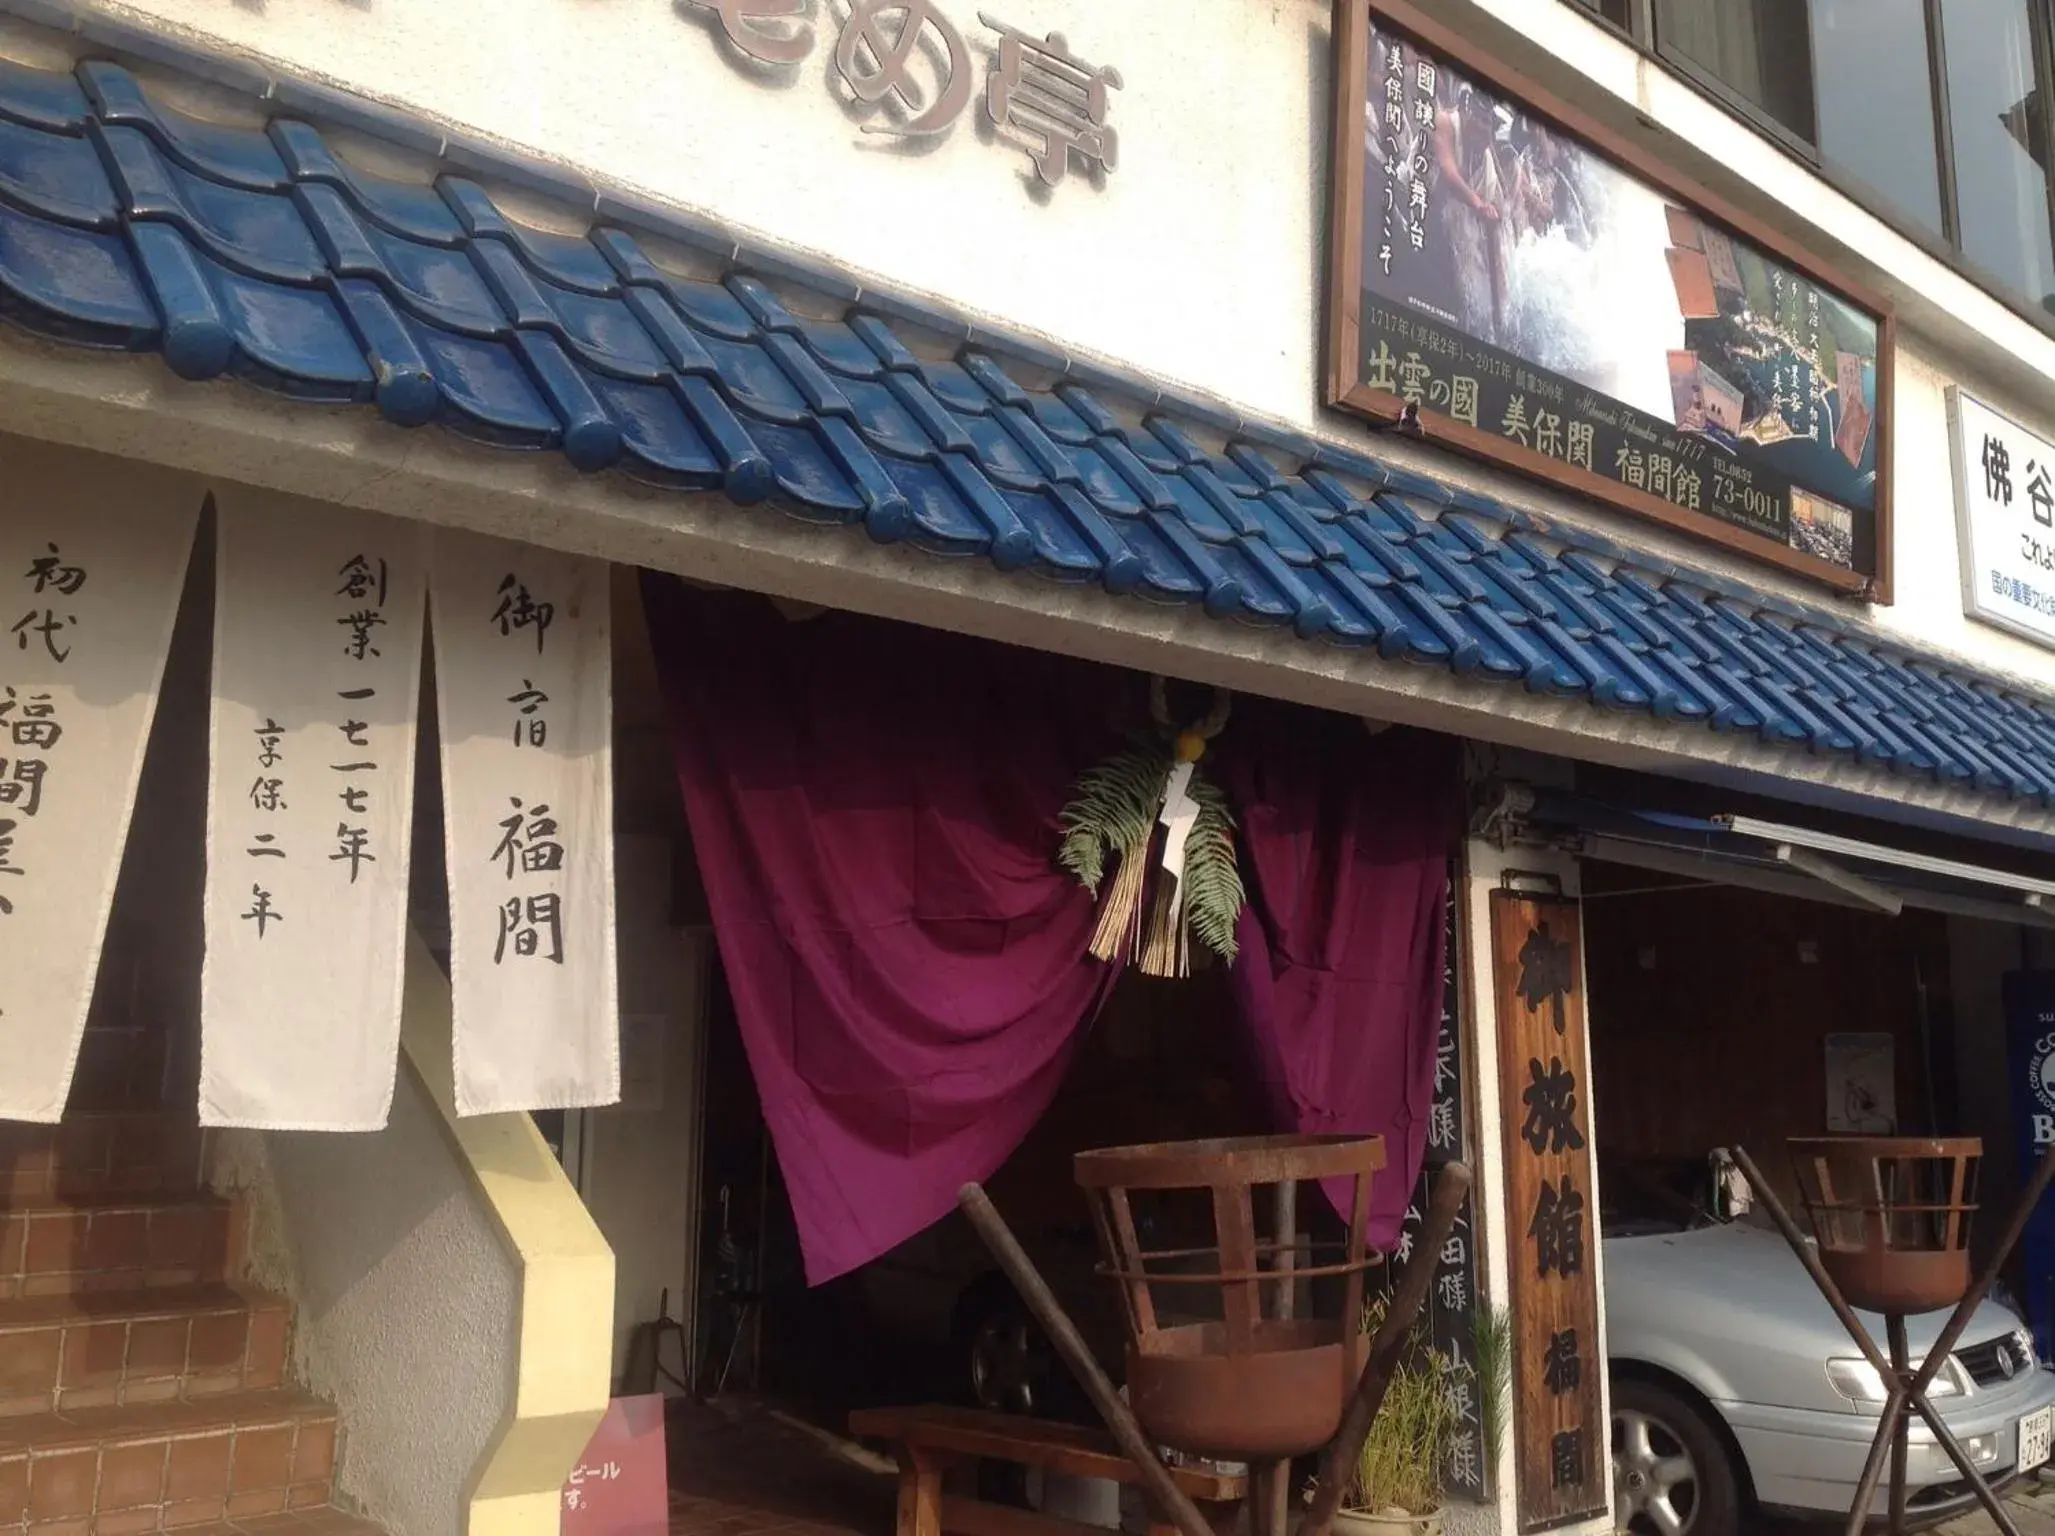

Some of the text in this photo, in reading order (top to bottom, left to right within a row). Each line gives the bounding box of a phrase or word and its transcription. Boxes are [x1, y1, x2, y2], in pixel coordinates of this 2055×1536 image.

[1368, 340, 1479, 428] 出雲の國
[1501, 394, 1595, 473] 美保関
[1615, 440, 1702, 511] 福間館
[1711, 475, 1782, 523] 73-0011
[2021, 533, 2055, 572] これよ
[241, 718, 288, 940] 享保二年
[490, 796, 565, 966] 福間
[569, 1461, 620, 1485] ビール
